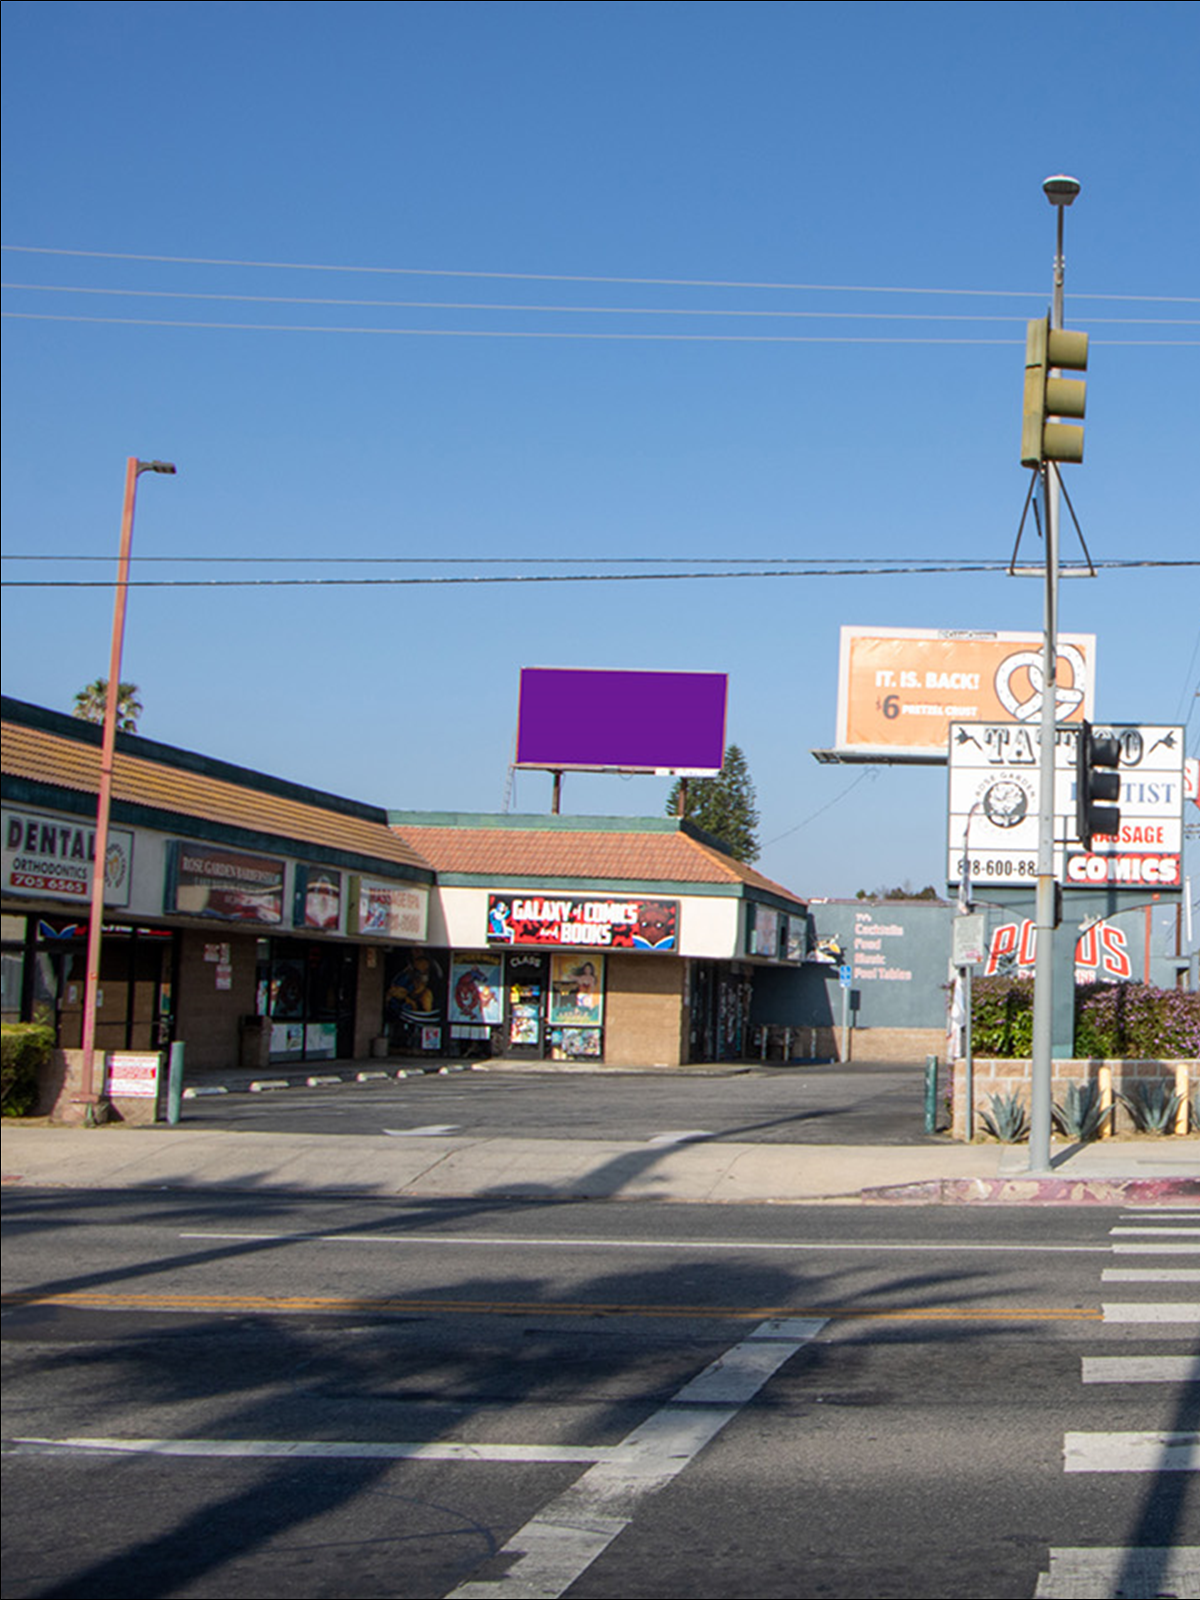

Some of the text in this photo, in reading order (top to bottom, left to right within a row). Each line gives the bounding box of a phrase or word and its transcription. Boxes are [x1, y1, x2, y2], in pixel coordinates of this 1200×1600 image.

[875, 671, 980, 690] IT. IS. BACK!
[902, 705, 978, 717] PRETZEL CRUST
[13, 858, 87, 879] ORTHODONTICS
[1067, 855, 1178, 881] COMICS
[15, 875, 83, 893] 705 6565
[512, 900, 571, 922] GALAXY
[583, 902, 638, 924] COMICS
[540, 923, 612, 945] and BOOKS
